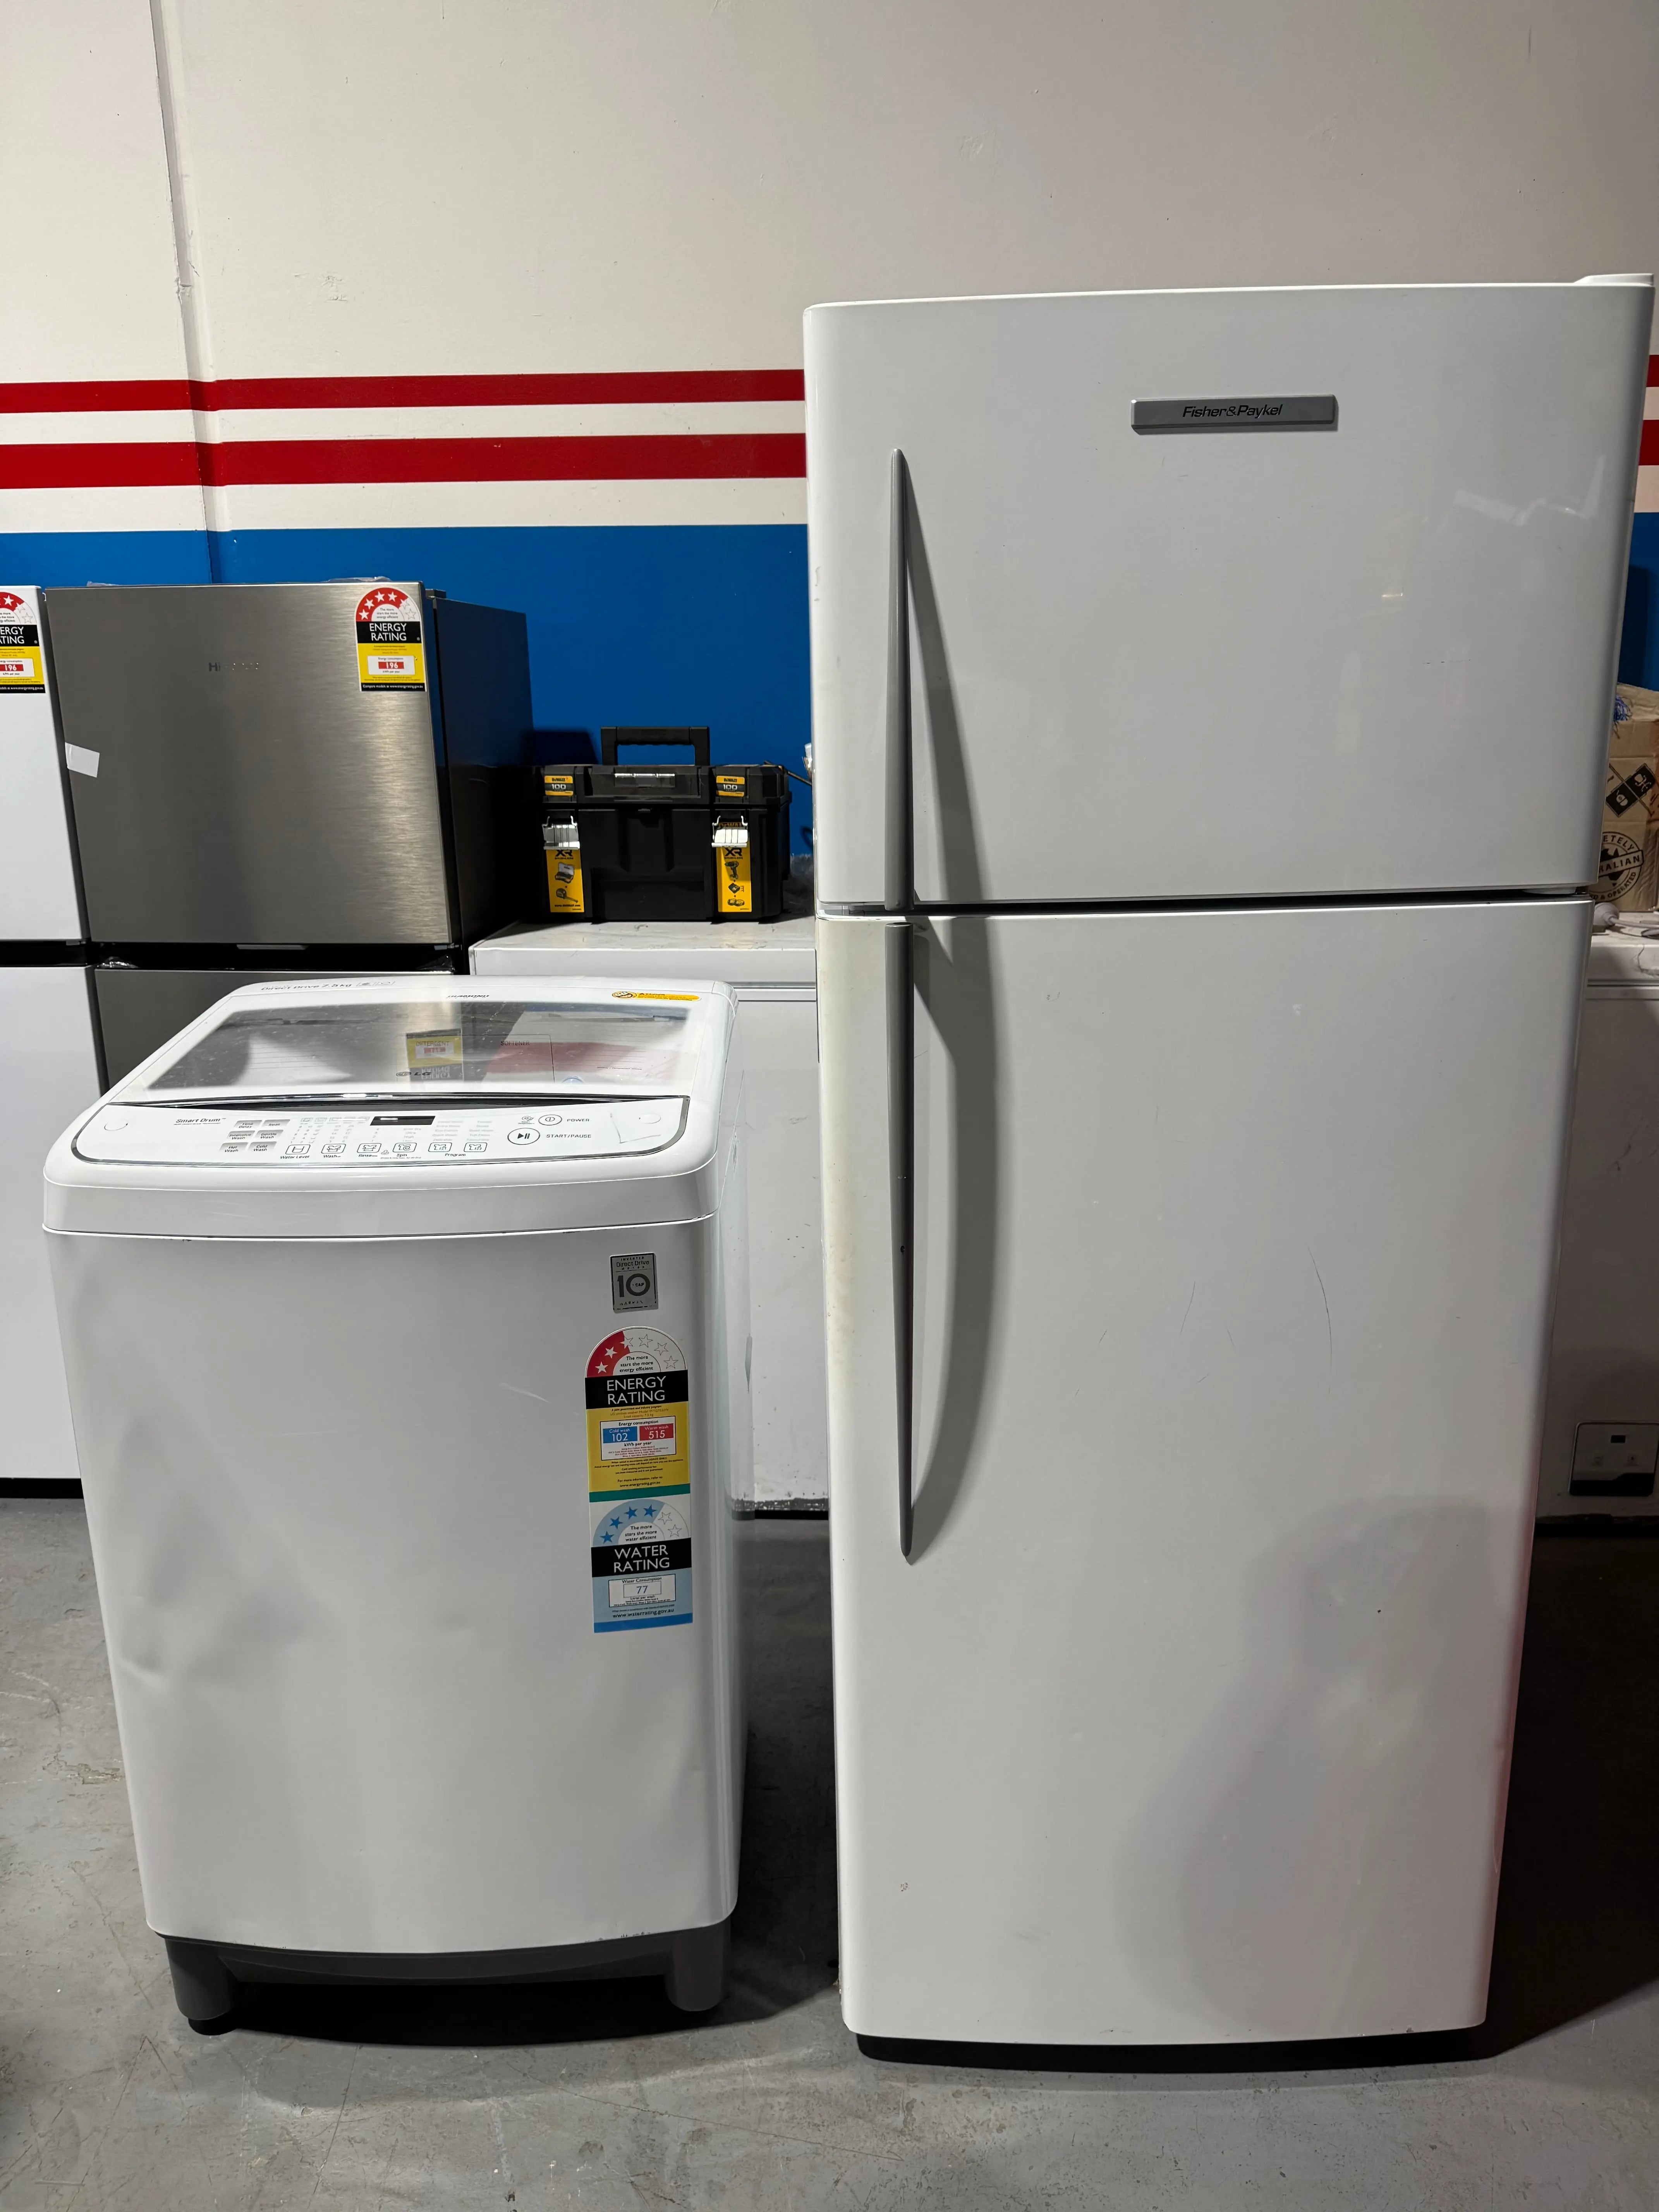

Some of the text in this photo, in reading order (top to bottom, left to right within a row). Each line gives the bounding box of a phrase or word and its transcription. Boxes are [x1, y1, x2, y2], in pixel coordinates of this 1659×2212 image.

[0, 627, 24, 635] ERGY
[369, 623, 407, 631] ENERGY
[371, 632, 407, 641] RATING
[1603, 835, 1635, 850] ETELY
[724, 847, 742, 856] XR
[1599, 855, 1640, 872] RALIAN
[1607, 872, 1636, 898] OPERATED
[617, 1273, 651, 1297] 10
[607, 1376, 666, 1391] ENERGY
[608, 1390, 665, 1405] RATING
[612, 1433, 628, 1442] 102
[649, 1430, 665, 1439] 515
[614, 1545, 668, 1559] WATER
[614, 1557, 670, 1573] RATING
[636, 1585, 648, 1594] 77
[613, 1609, 674, 1618] www.waterrating.gov.au
